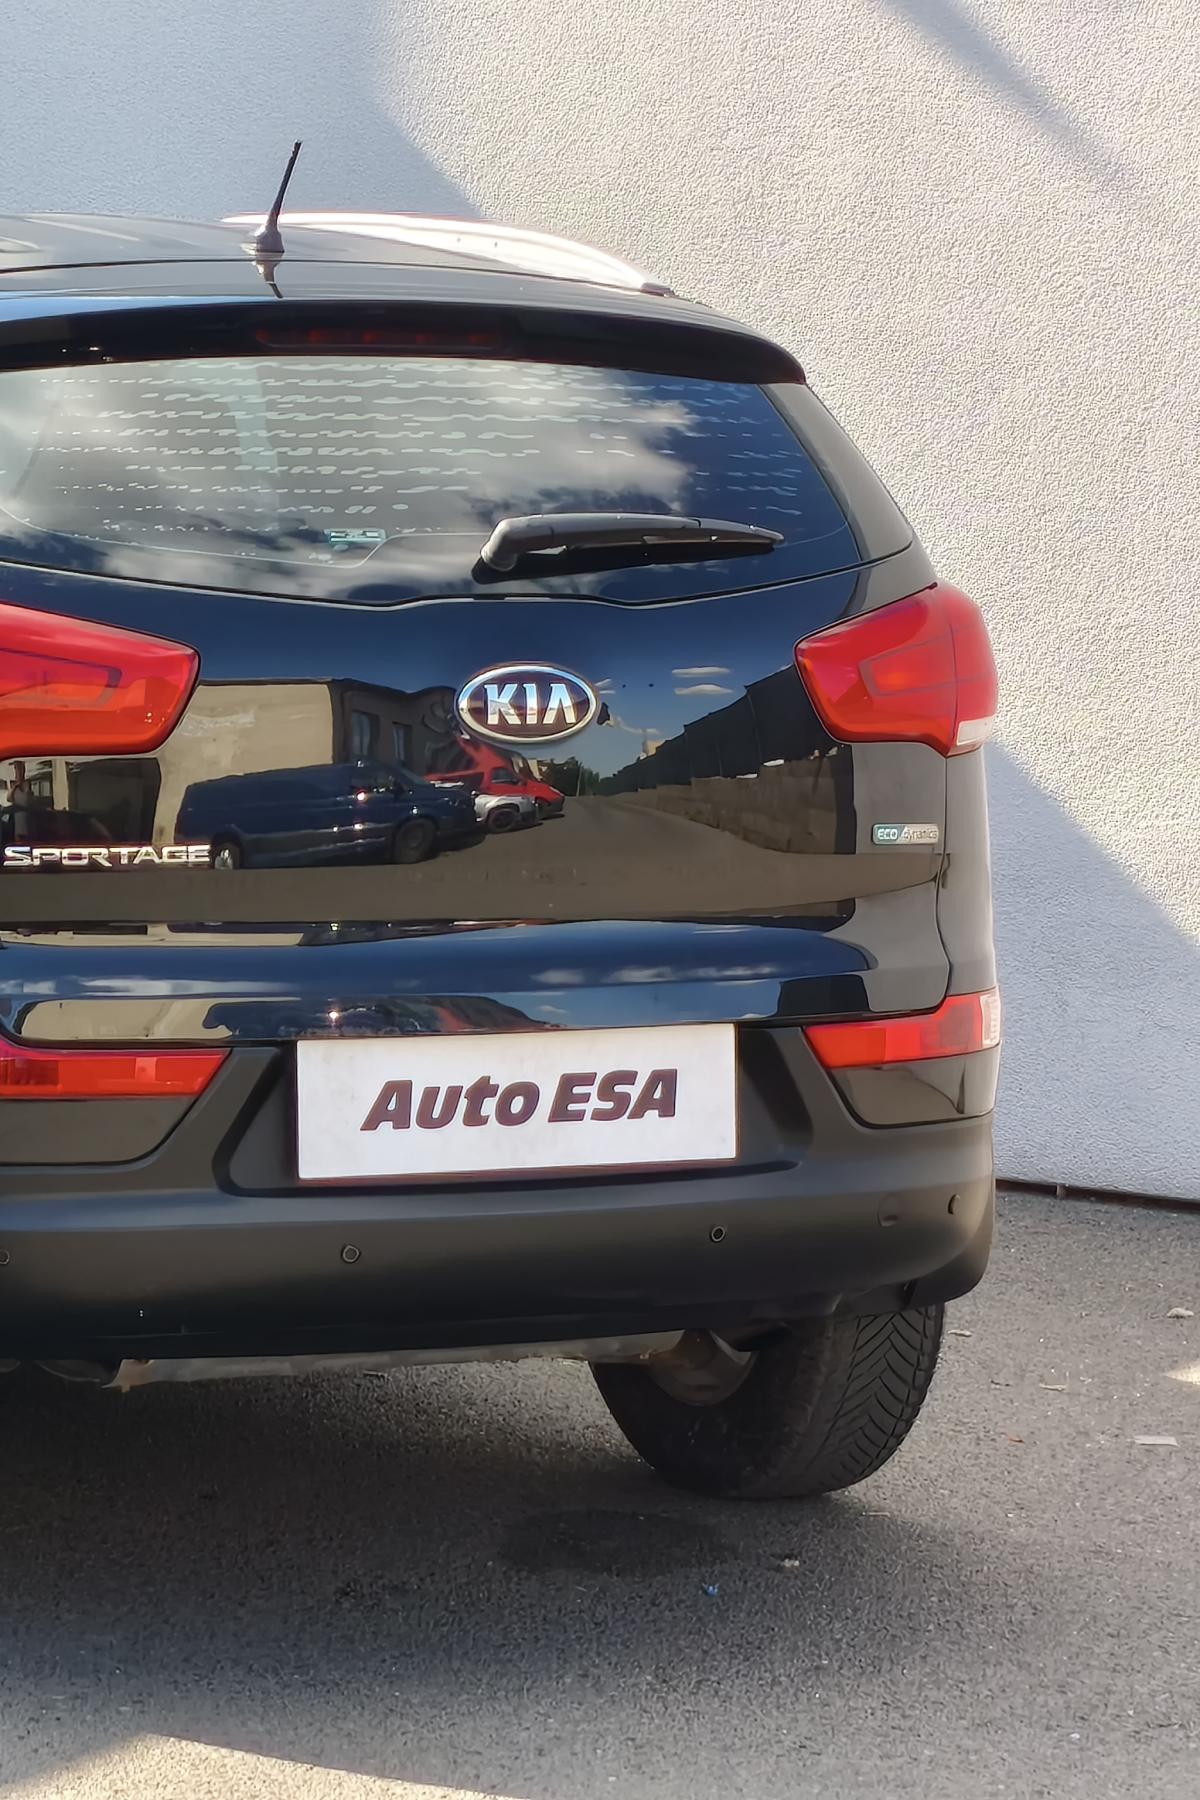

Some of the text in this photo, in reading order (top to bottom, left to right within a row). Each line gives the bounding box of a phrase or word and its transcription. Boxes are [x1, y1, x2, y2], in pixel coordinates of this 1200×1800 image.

[484, 683, 577, 725] KIA
[877, 828, 898, 840] ECO
[3, 845, 211, 868] SPORTAGE
[360, 1068, 678, 1132] Auto ESA
